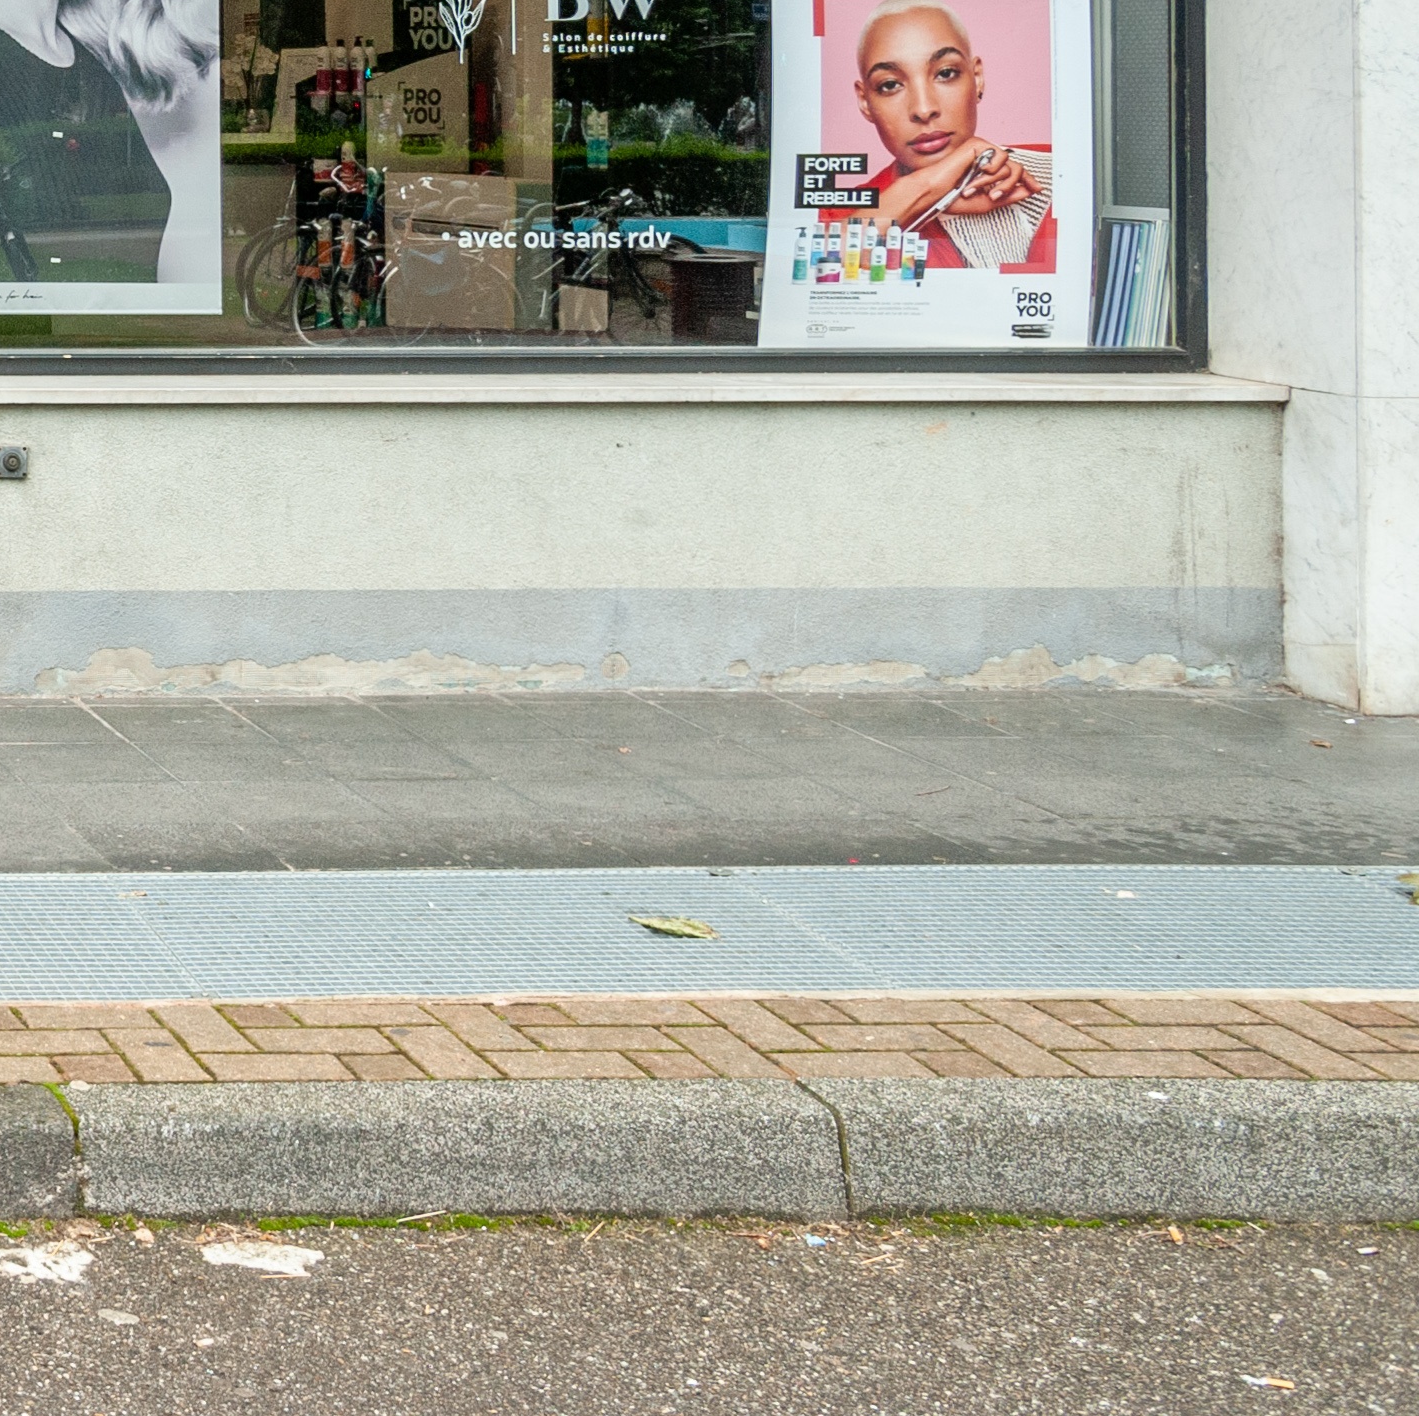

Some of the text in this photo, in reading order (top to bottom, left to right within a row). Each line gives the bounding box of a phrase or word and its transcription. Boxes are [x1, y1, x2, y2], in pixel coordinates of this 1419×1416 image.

[409, 28, 453, 51] YOU
[542, 32, 667, 42] Salon de coiffure
[542, 43, 635, 55] & Esthétique
[402, 88, 442, 106] PRO
[402, 106, 442, 124] YOU
[804, 157, 862, 172] FORTE
[803, 174, 827, 189] ET
[802, 191, 873, 205] REBELLE
[458, 224, 672, 249] avec ou sans rdv
[1017, 292, 1052, 304] PRO
[1016, 305, 1051, 317] YOU
